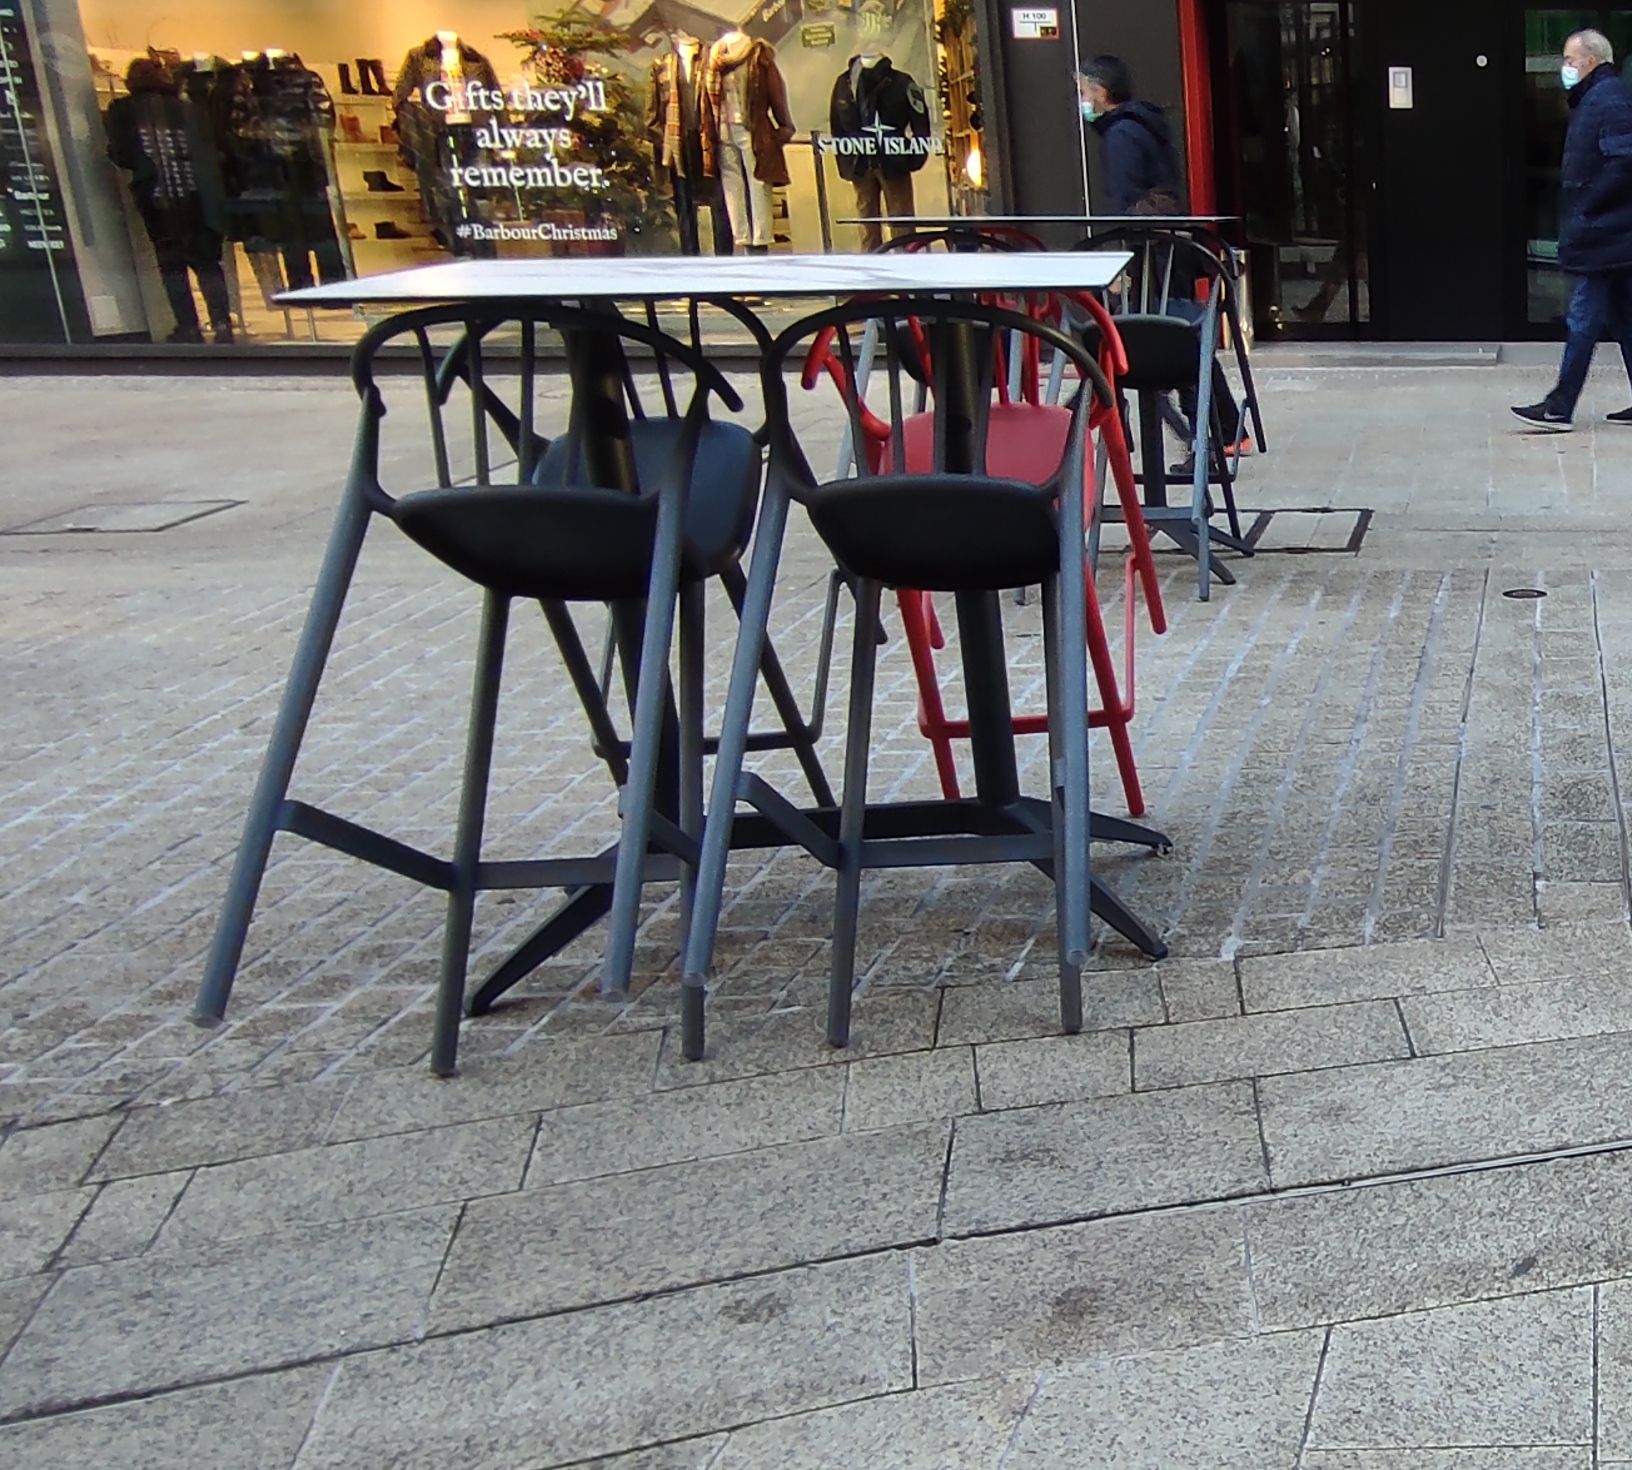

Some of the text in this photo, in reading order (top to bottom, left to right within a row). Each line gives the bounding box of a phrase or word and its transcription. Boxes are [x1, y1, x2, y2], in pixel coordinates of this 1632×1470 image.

[1032, 12, 1047, 20] 100
[425, 80, 504, 111] Gifts
[475, 114, 573, 161] always
[818, 136, 946, 156] STONE ISLAND
[450, 157, 611, 188] remember.
[455, 222, 619, 241] #BarbourChristmas
